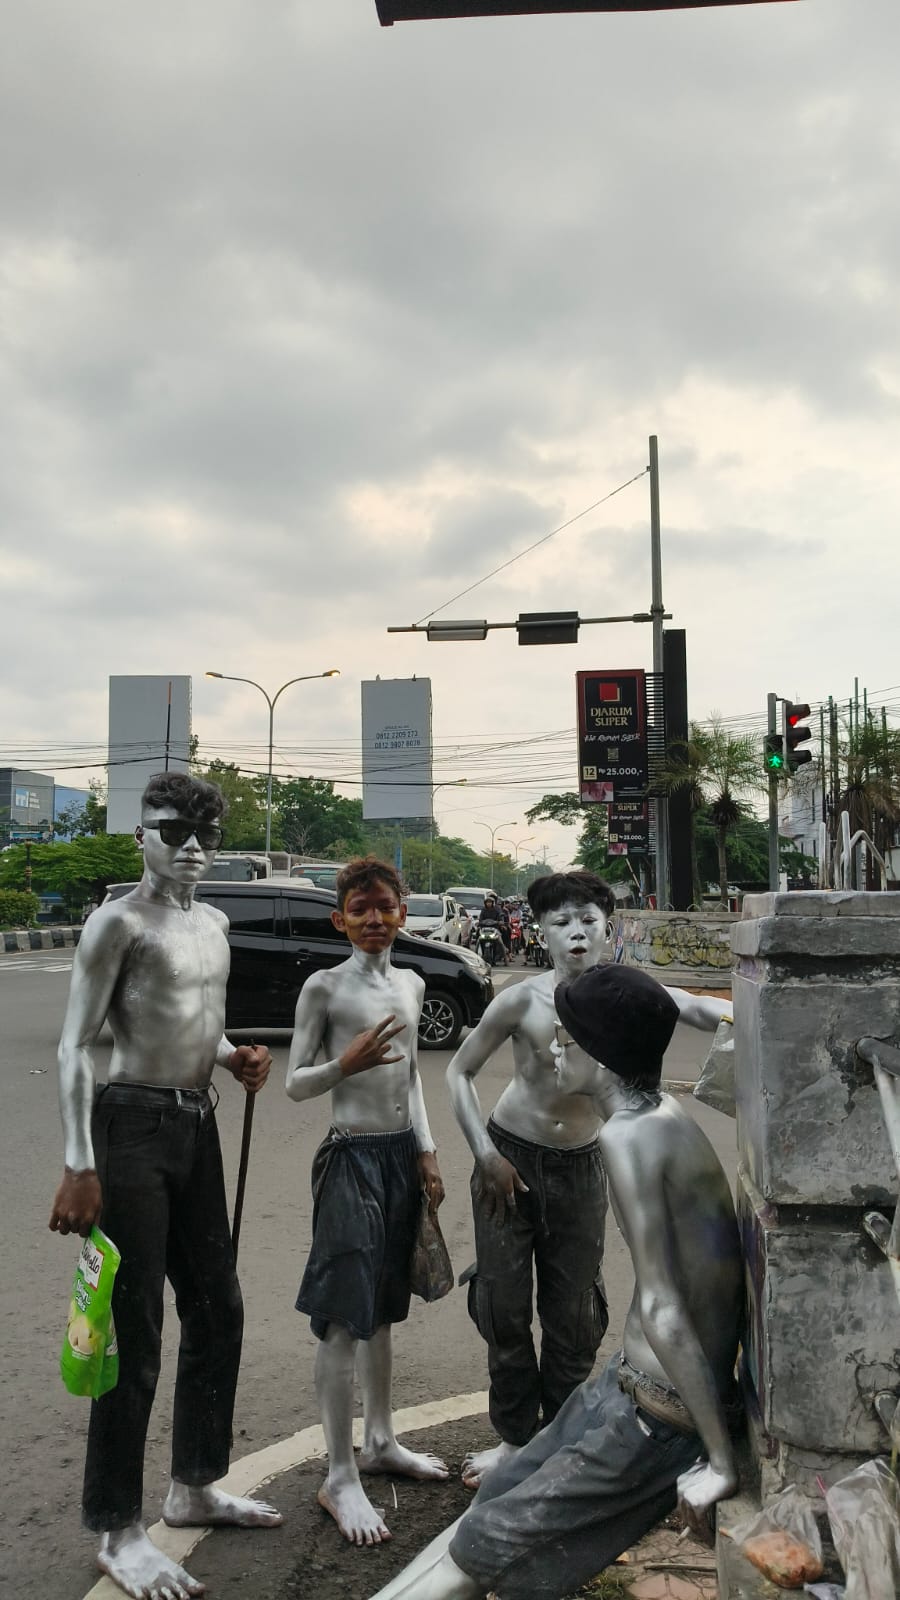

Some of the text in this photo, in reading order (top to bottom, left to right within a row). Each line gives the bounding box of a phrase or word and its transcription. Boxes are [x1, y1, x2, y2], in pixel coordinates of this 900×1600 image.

[590, 706, 633, 717] DJARUM
[595, 716, 629, 727] SUPER
[584, 767, 595, 776] 12
